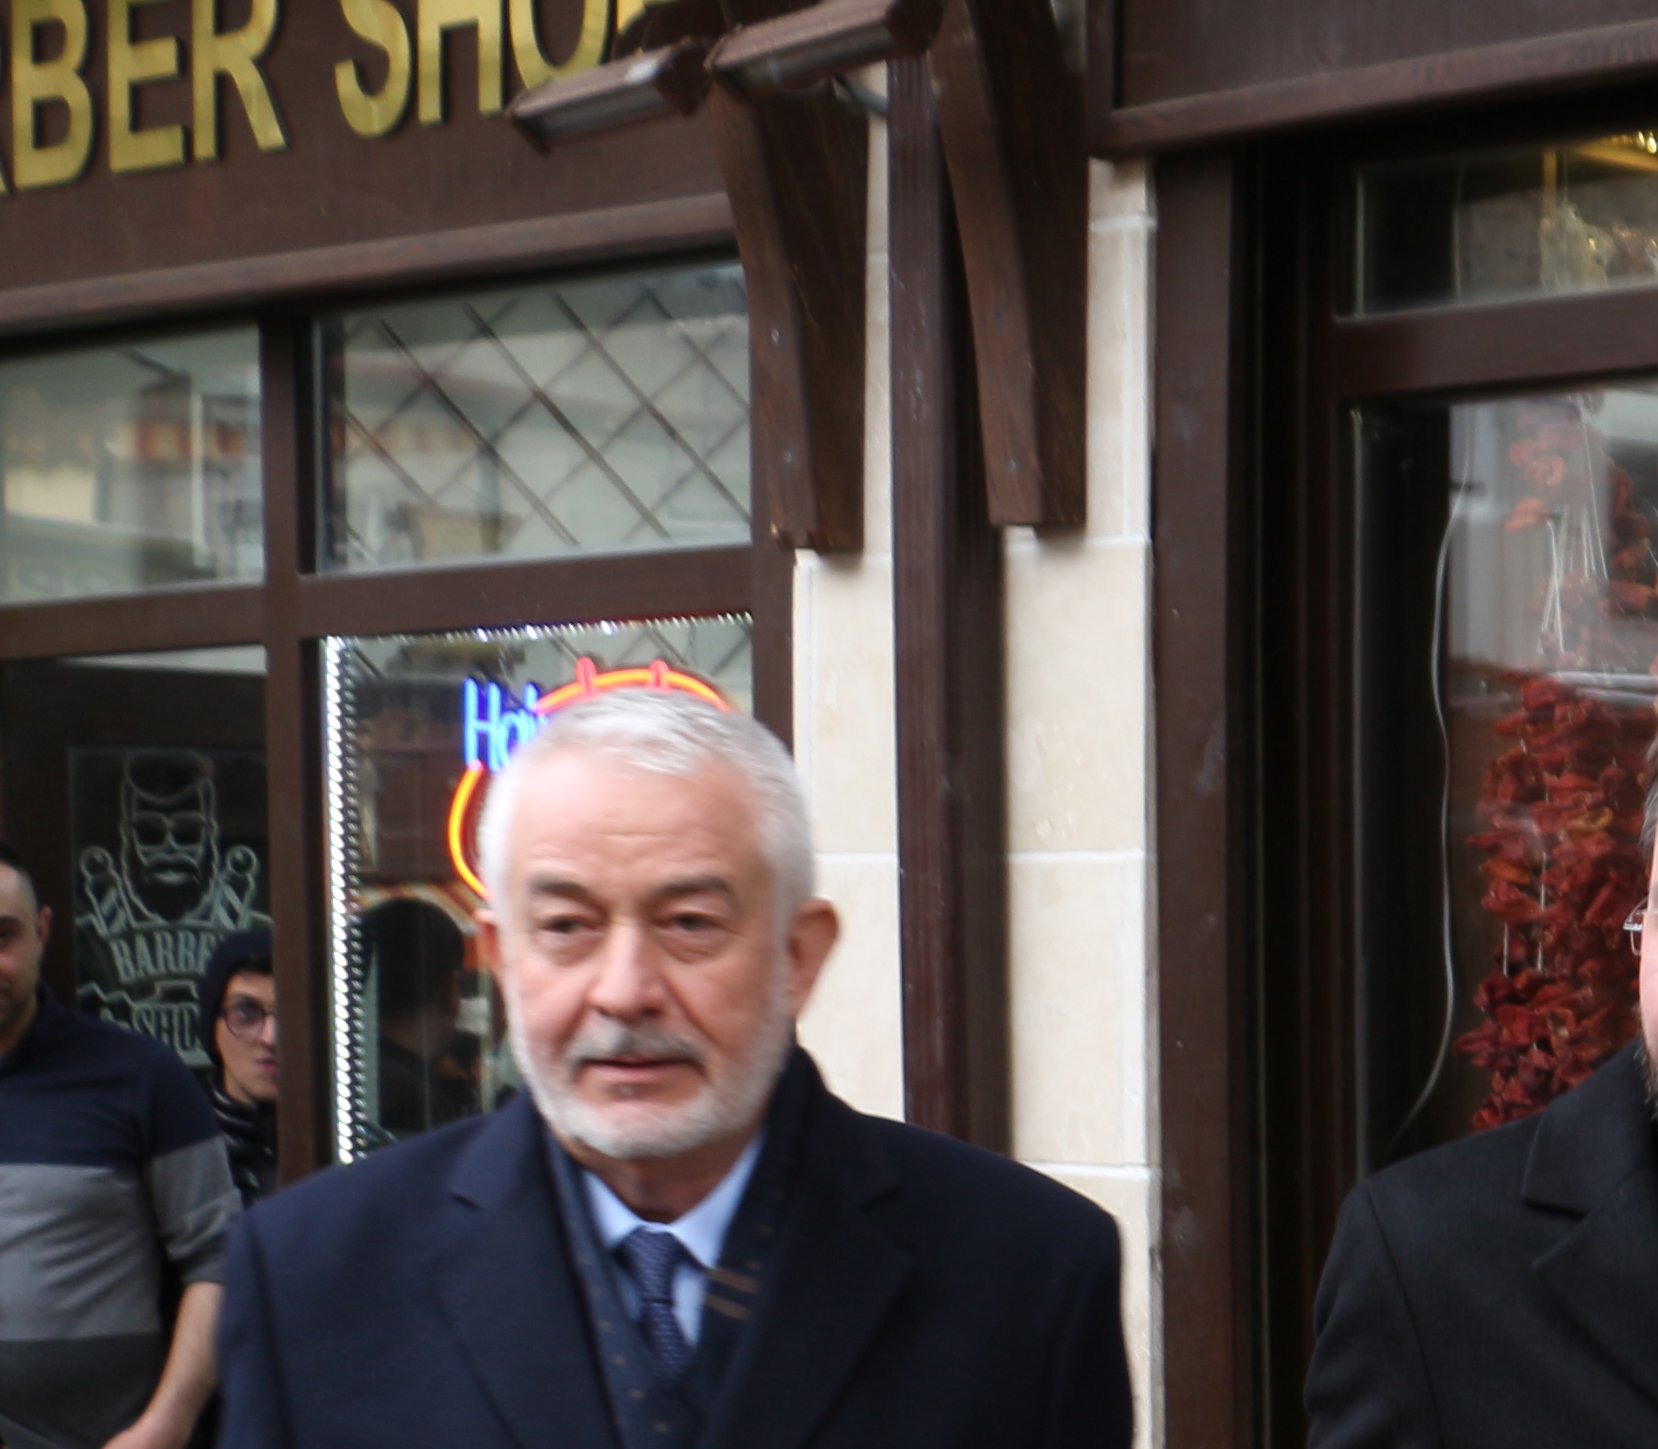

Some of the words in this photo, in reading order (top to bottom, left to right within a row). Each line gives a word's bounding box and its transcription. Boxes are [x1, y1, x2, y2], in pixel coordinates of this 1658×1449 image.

[0, 0, 289, 194] BER
[335, 0, 655, 138] SHO
[110, 930, 220, 984] BARBE
